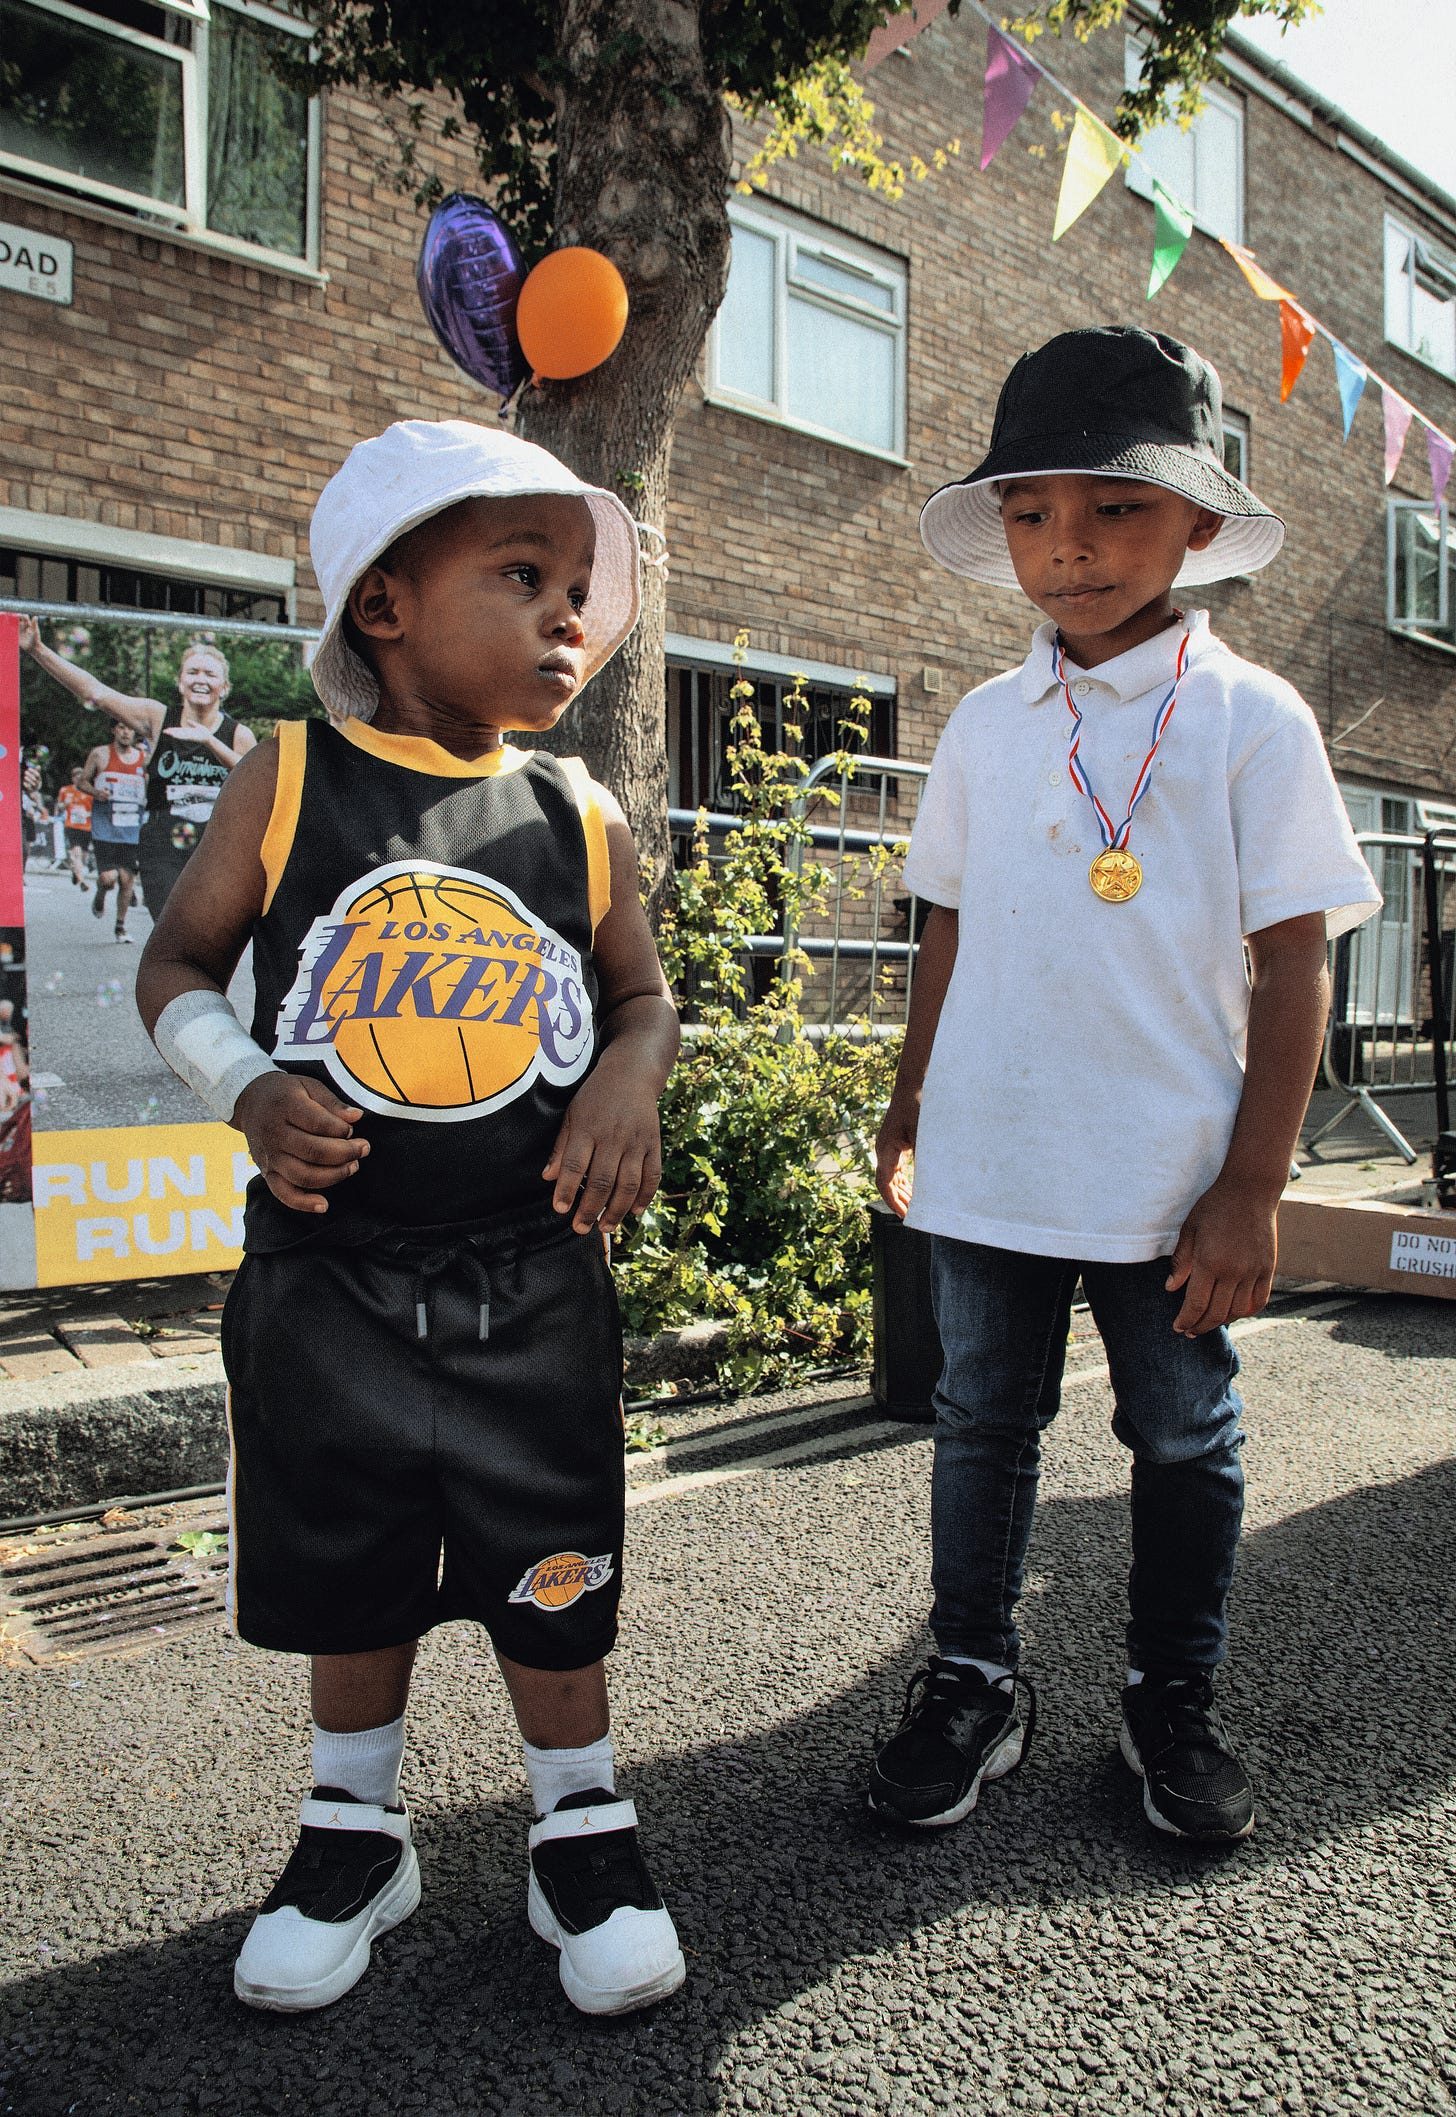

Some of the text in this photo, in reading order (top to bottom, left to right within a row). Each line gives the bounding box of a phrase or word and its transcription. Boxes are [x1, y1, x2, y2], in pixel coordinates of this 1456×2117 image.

[378, 921, 579, 974] LOS ANGELES
[283, 921, 592, 1069] LAKERS
[32, 1154, 207, 1209] RUN
[76, 1205, 247, 1262] RUN
[1397, 1233, 1420, 1249] DO
[1396, 1256, 1455, 1276] CRUSH
[514, 1563, 608, 1599] LAKERS
[564, 1556, 608, 1569] ANGELES
